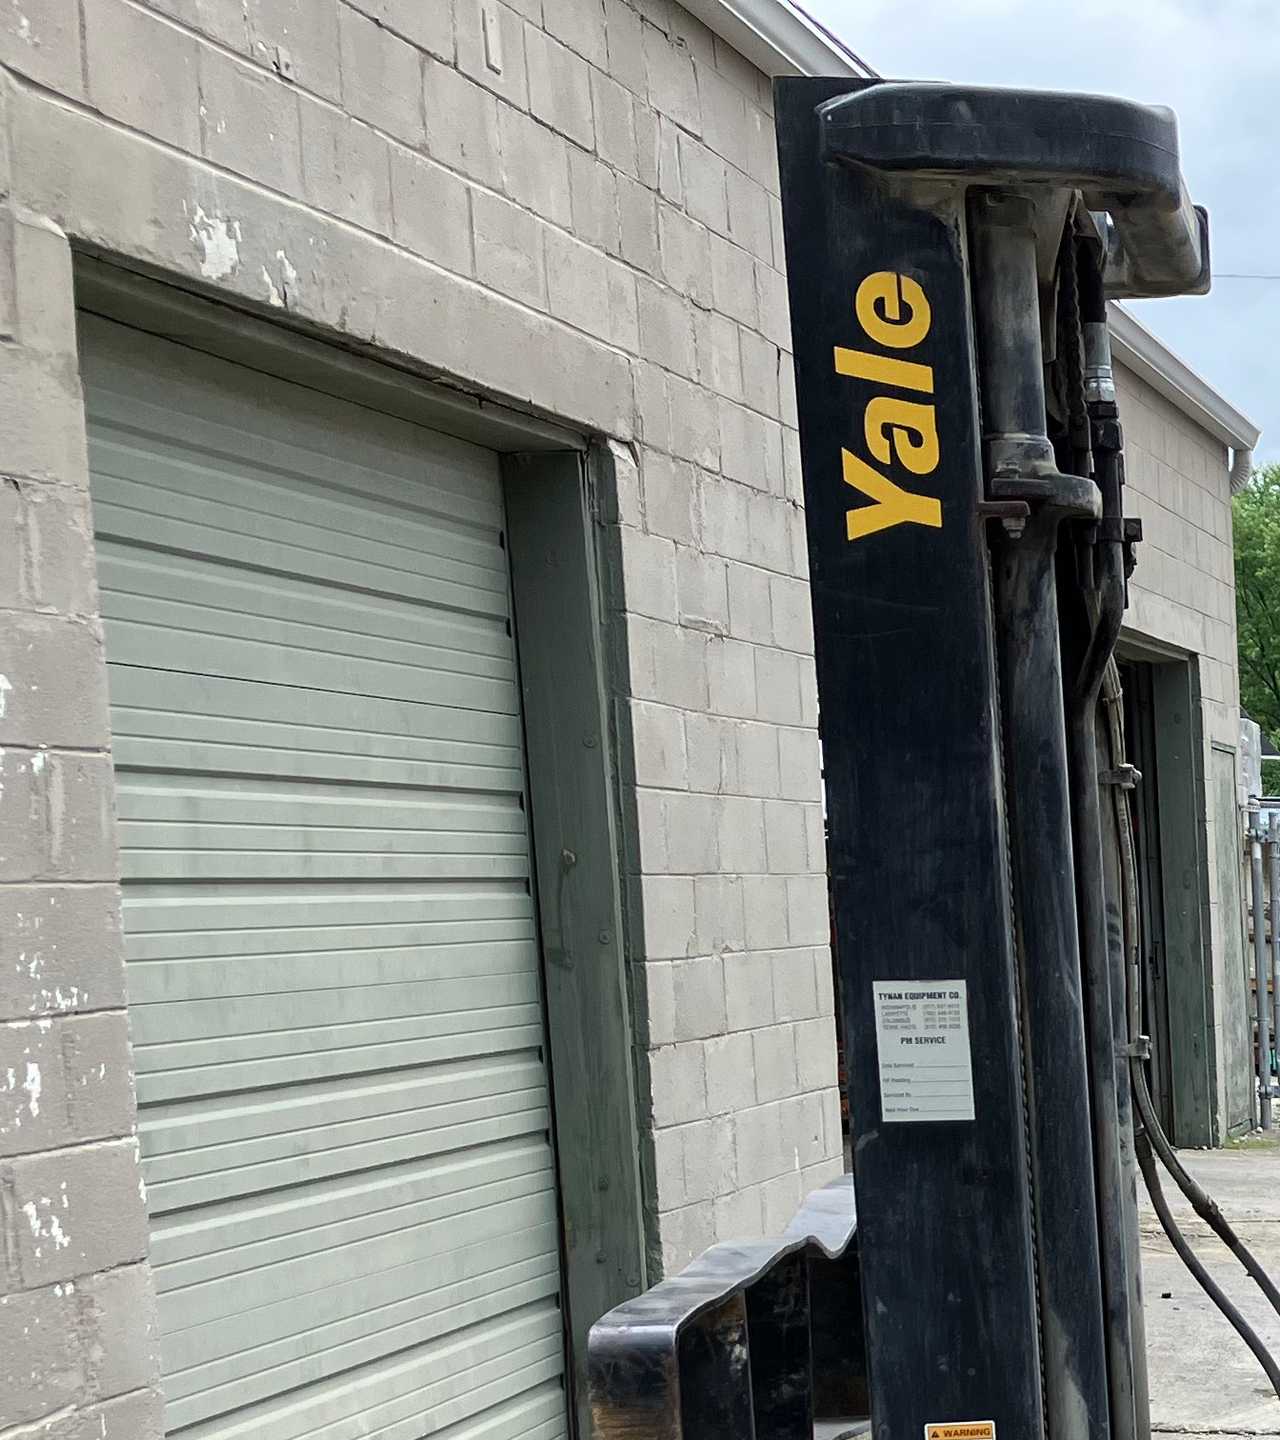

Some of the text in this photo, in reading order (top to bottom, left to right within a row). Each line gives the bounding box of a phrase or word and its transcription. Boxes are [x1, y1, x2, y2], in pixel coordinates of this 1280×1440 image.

[834, 271, 942, 541] Yale
[878, 992, 903, 1001] TYNAN
[905, 991, 947, 1000] EQUIPMENT
[900, 1036, 947, 1045] PM SERVICE
[943, 1428, 990, 1439] WARNING
